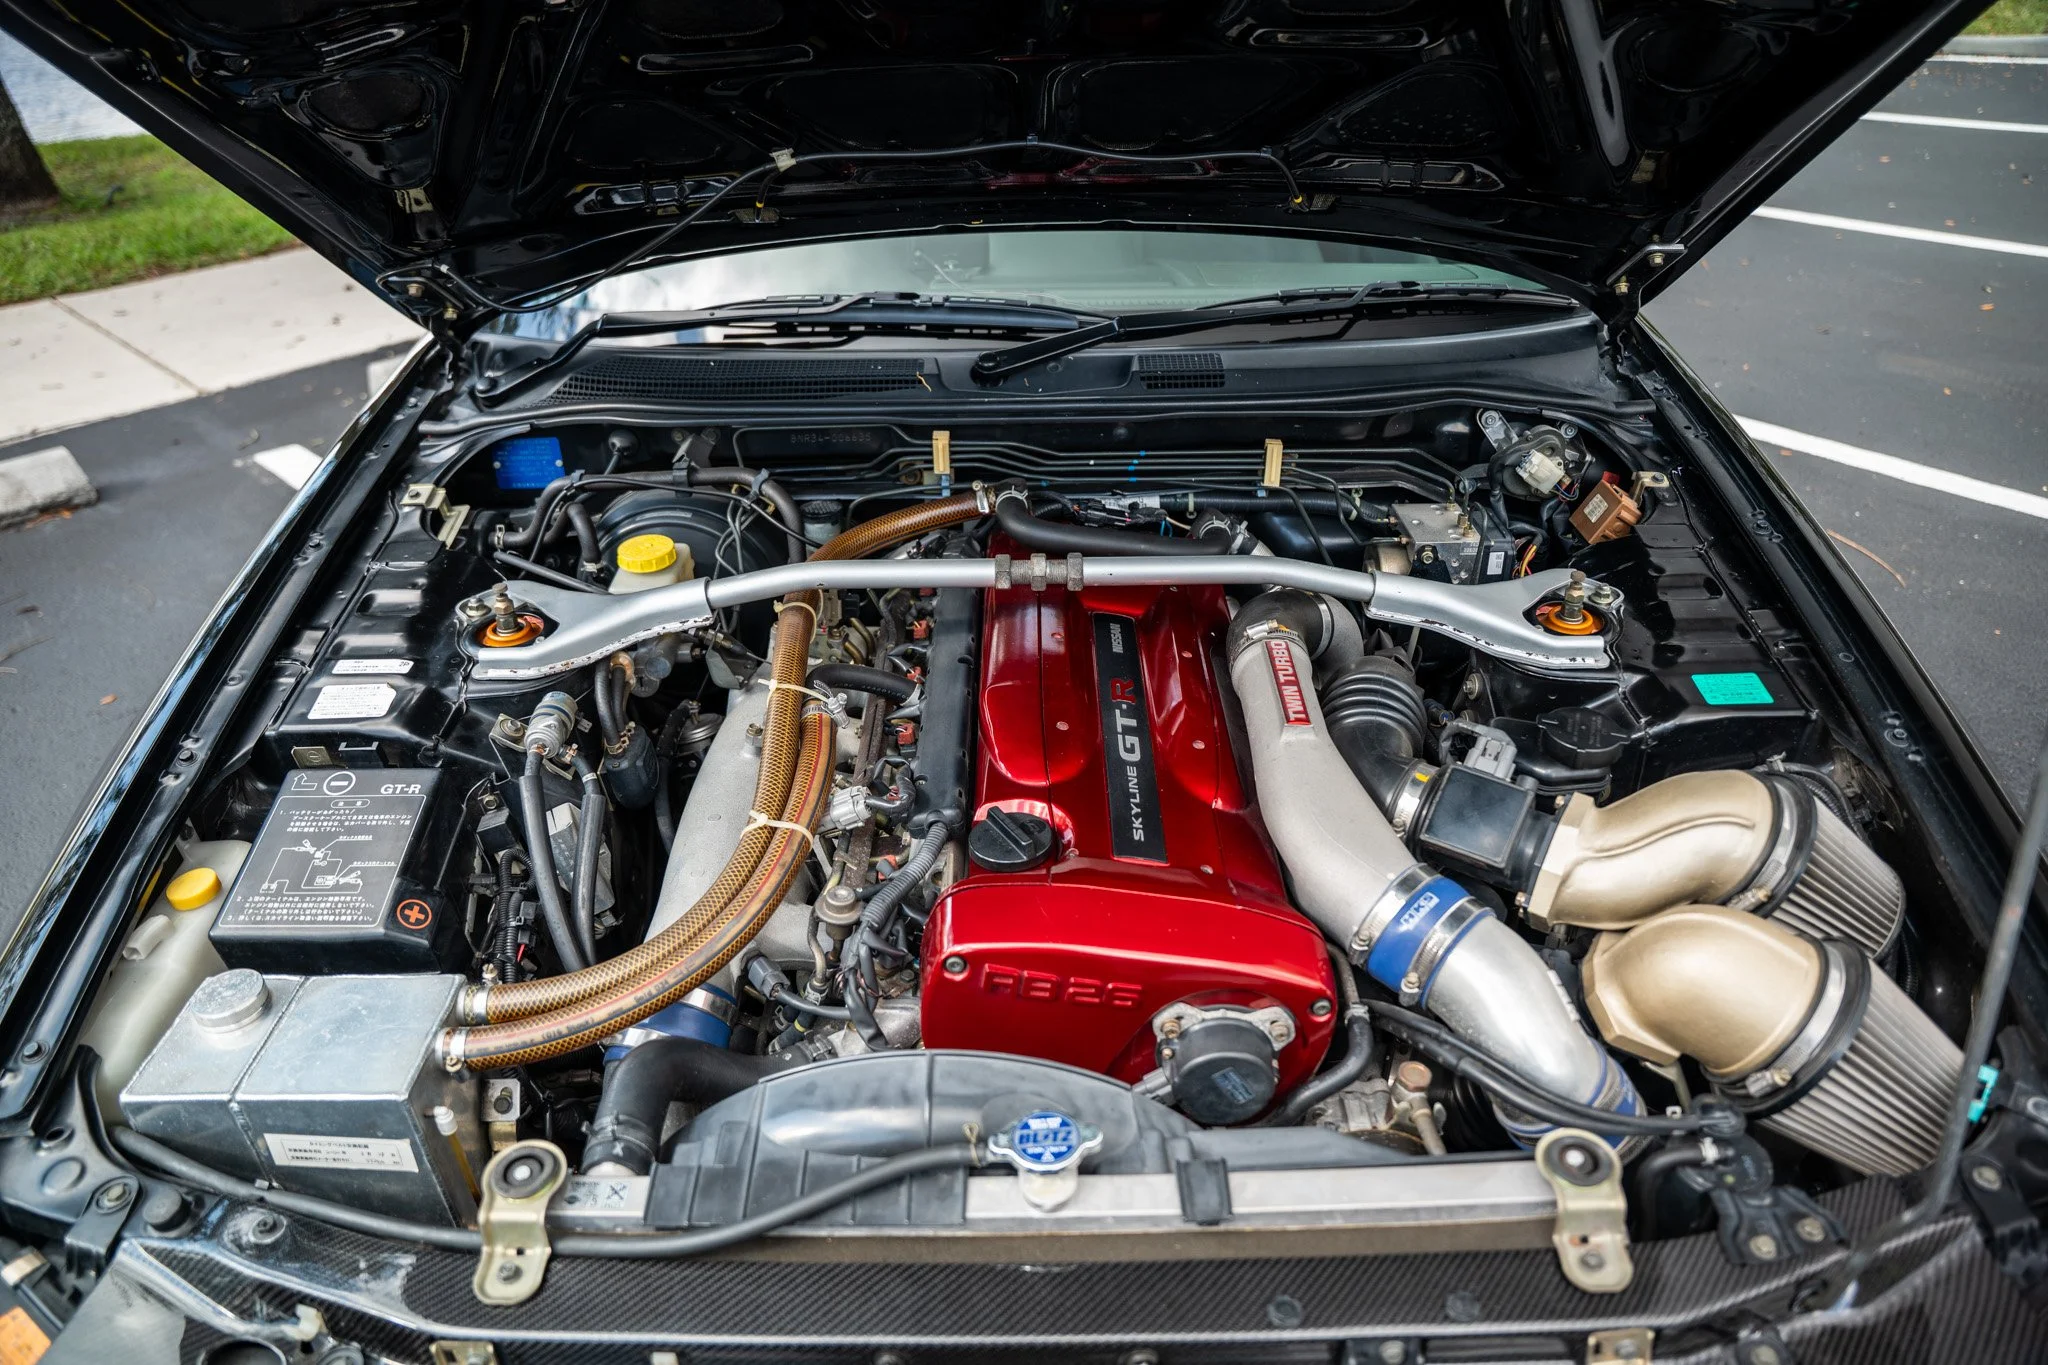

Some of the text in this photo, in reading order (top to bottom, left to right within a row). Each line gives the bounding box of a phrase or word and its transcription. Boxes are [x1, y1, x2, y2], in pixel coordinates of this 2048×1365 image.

[1110, 623, 1123, 653] NISSAN
[1270, 641, 1306, 721] TWIN TURBO
[380, 784, 422, 794] GT-R
[1127, 766, 1144, 841] SKYLINE
[1401, 892, 1439, 928] HKS
[980, 963, 1142, 1006] RB26
[1018, 1130, 1072, 1144] BLITZ
